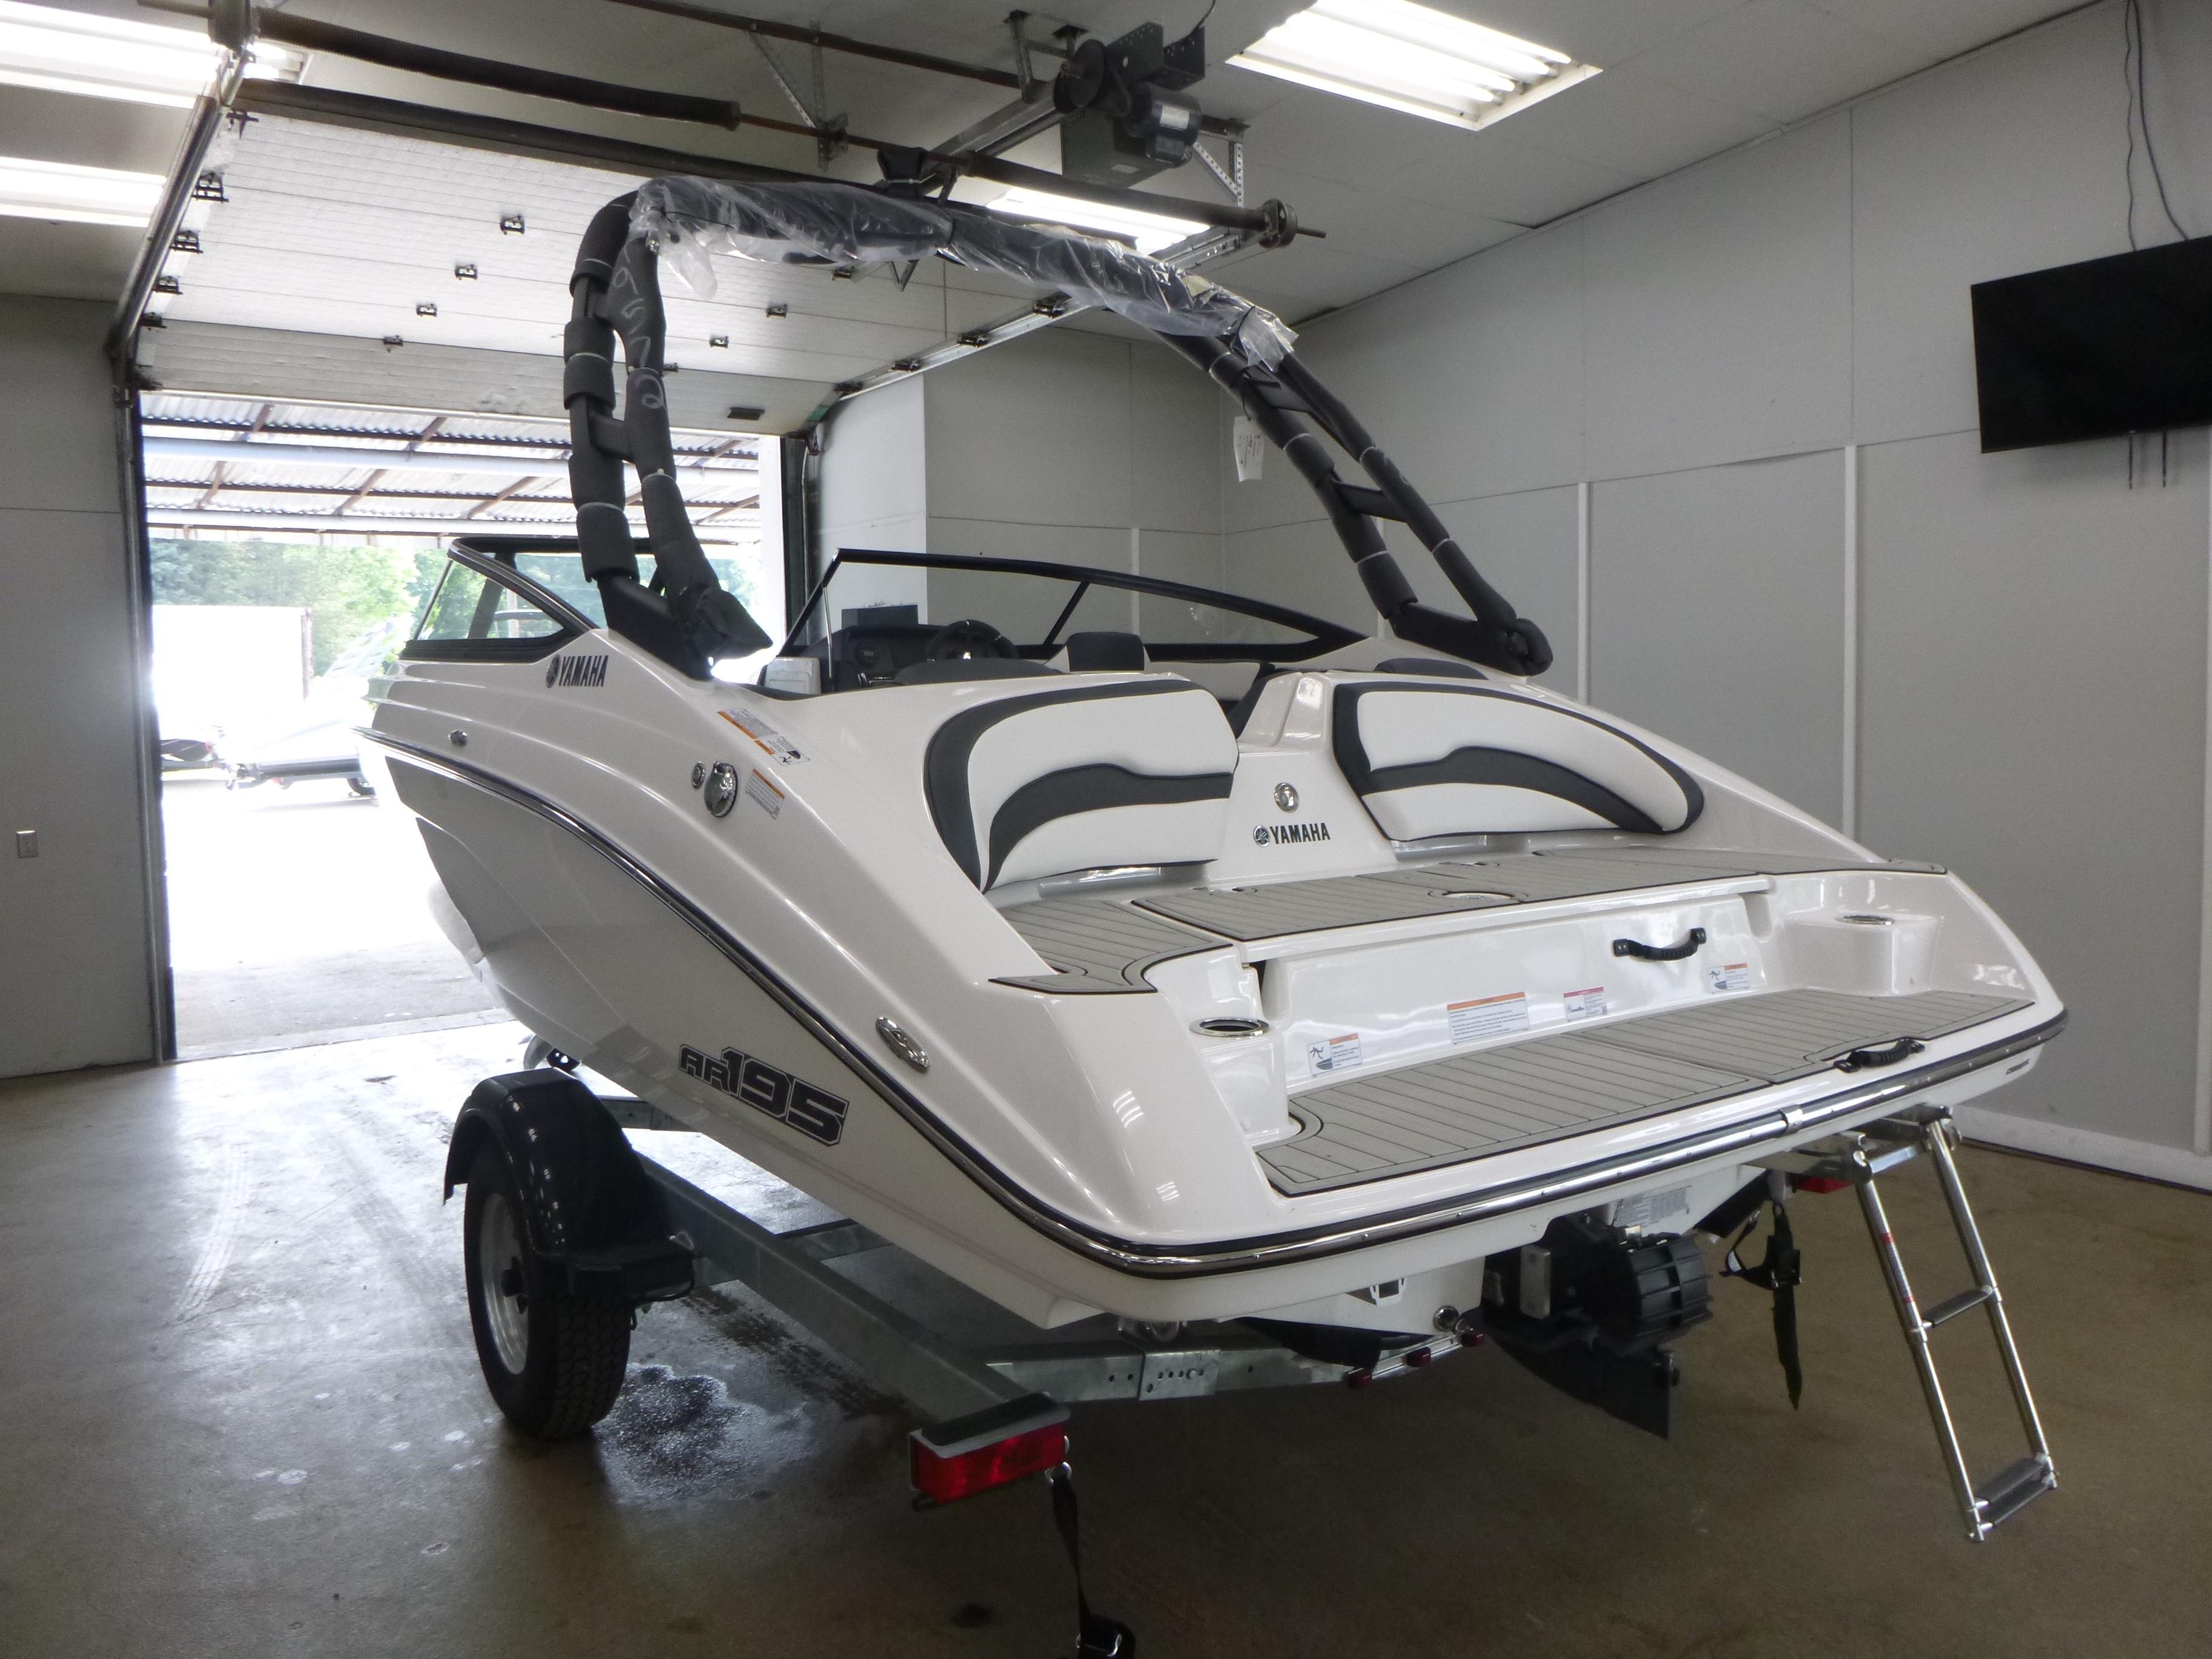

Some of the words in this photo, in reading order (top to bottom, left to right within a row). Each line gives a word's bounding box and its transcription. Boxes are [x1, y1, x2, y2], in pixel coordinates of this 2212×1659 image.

[558, 655, 609, 687] YAMAHA
[1270, 822, 1331, 845] YAMAHA
[678, 1043, 850, 1147] AR195
